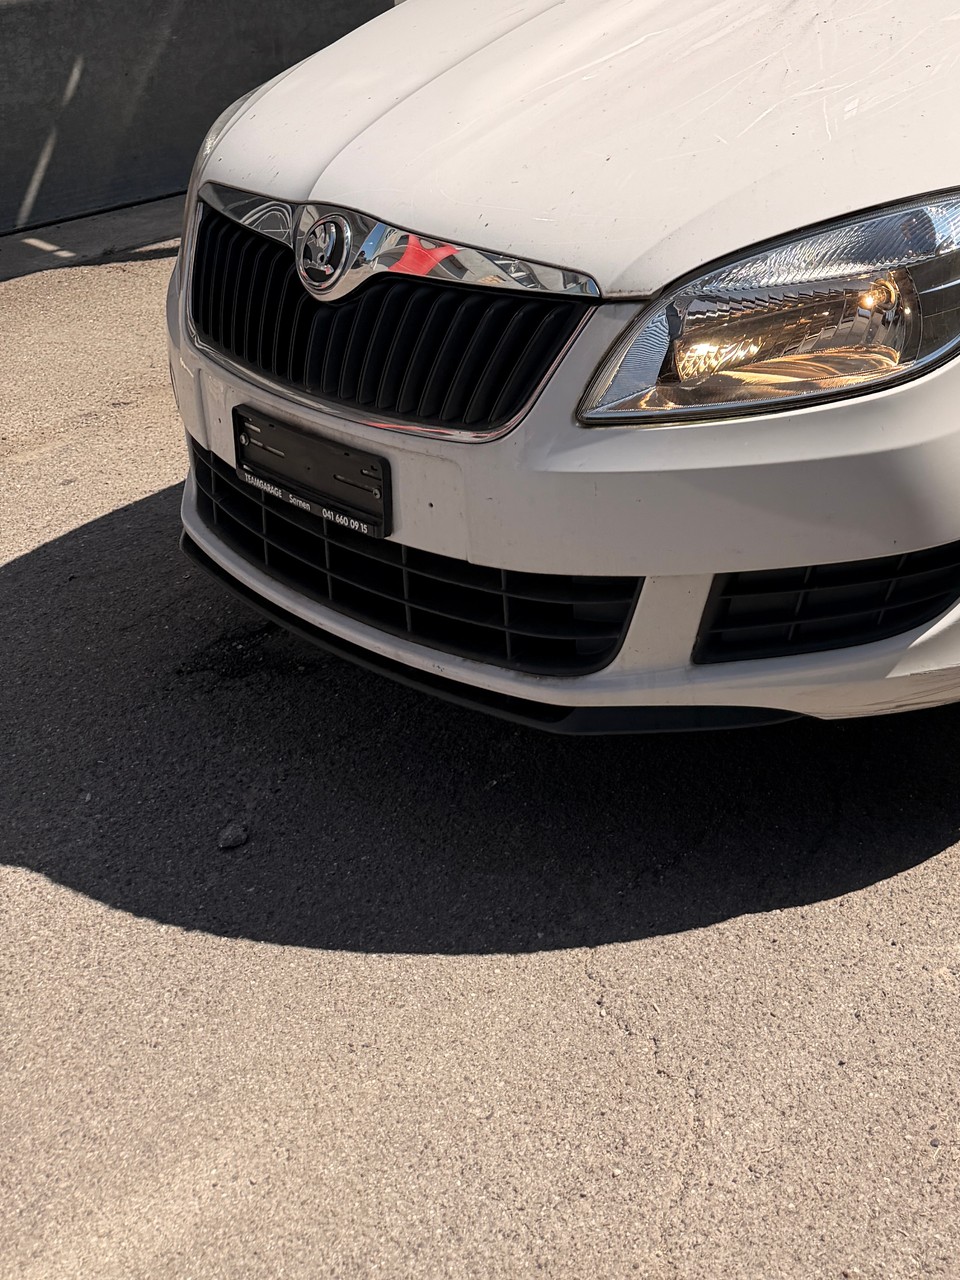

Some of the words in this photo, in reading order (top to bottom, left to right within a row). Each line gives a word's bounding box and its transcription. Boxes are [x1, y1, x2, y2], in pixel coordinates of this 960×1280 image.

[244, 473, 283, 498] TEAMGARAGE
[289, 494, 311, 511] Sarnen
[322, 508, 334, 521] 041
[335, 514, 348, 526] 660
[350, 518, 359, 531] 09
[360, 522, 368, 534] 15
